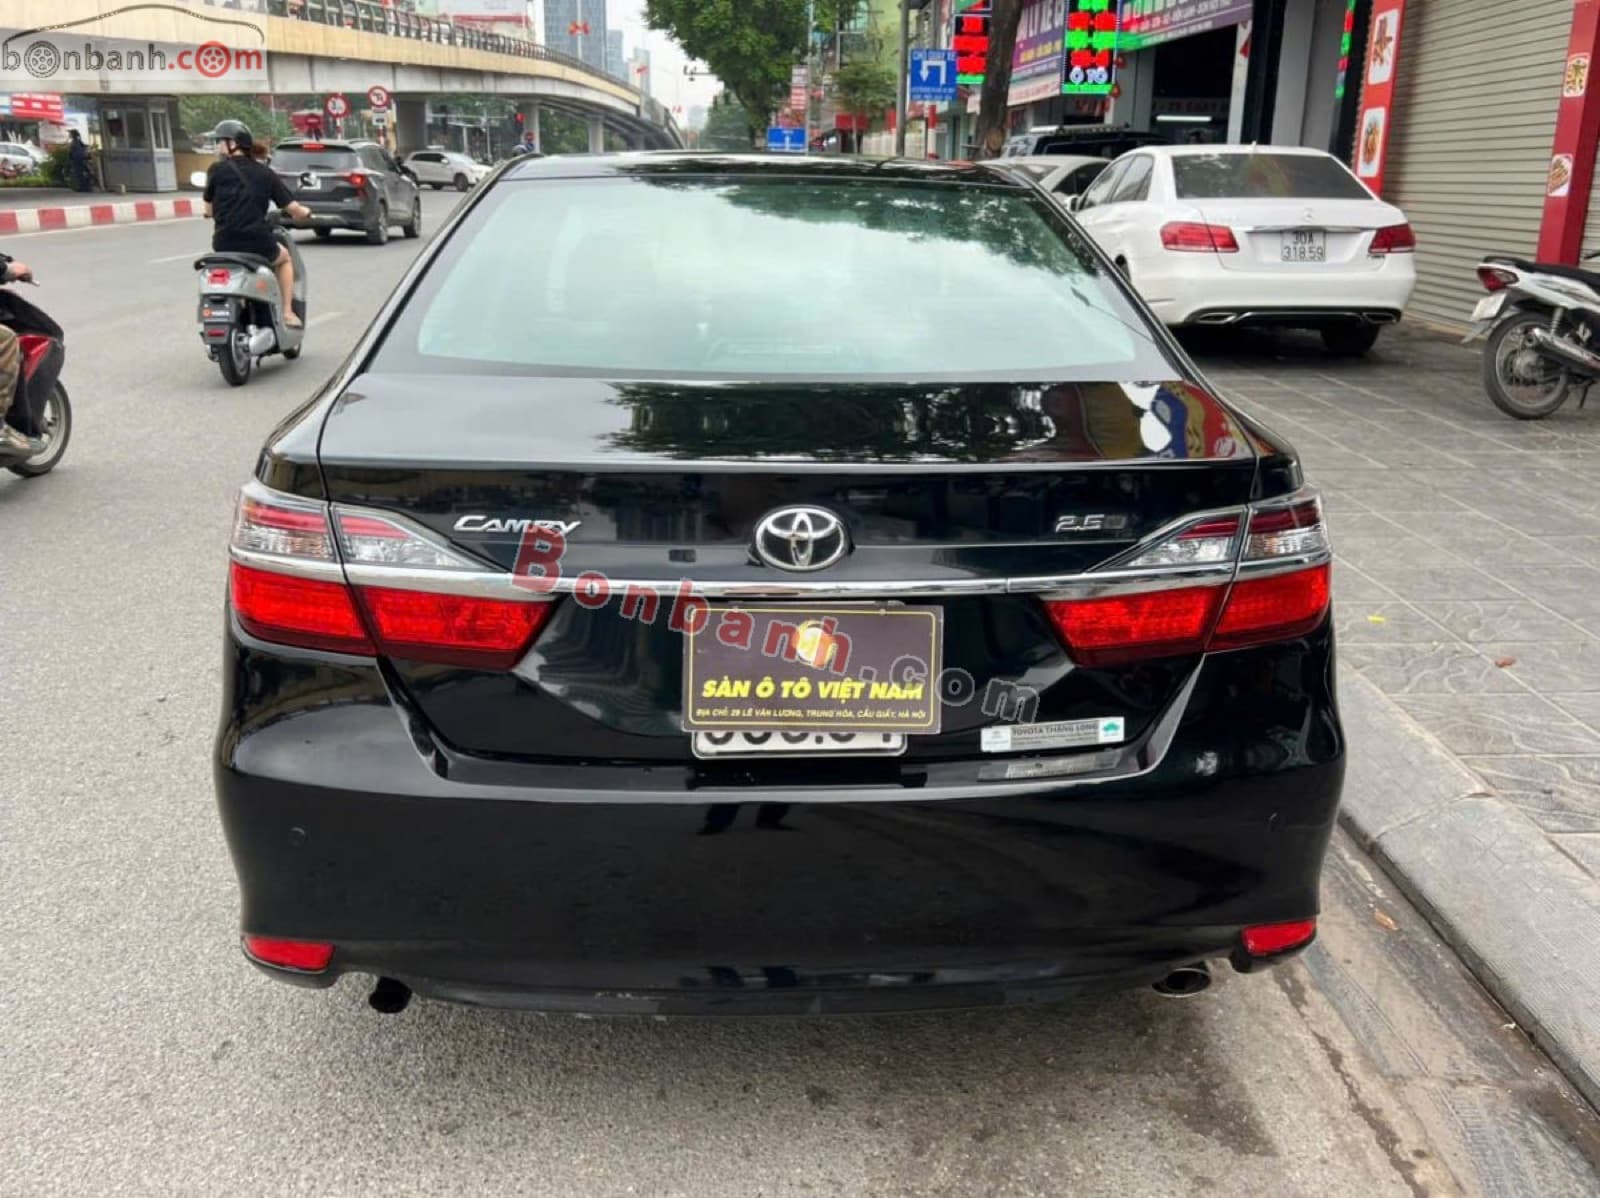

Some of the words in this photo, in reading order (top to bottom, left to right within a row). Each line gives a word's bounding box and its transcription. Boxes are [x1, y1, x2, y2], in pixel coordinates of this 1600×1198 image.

[453, 515, 581, 533] CAMRY
[756, 676, 775, 698] Ô
[781, 677, 812, 698] TÔ
[818, 677, 866, 704] VIỆT
[869, 681, 923, 699] NAM
[1013, 728, 1043, 736] TOYOTA
